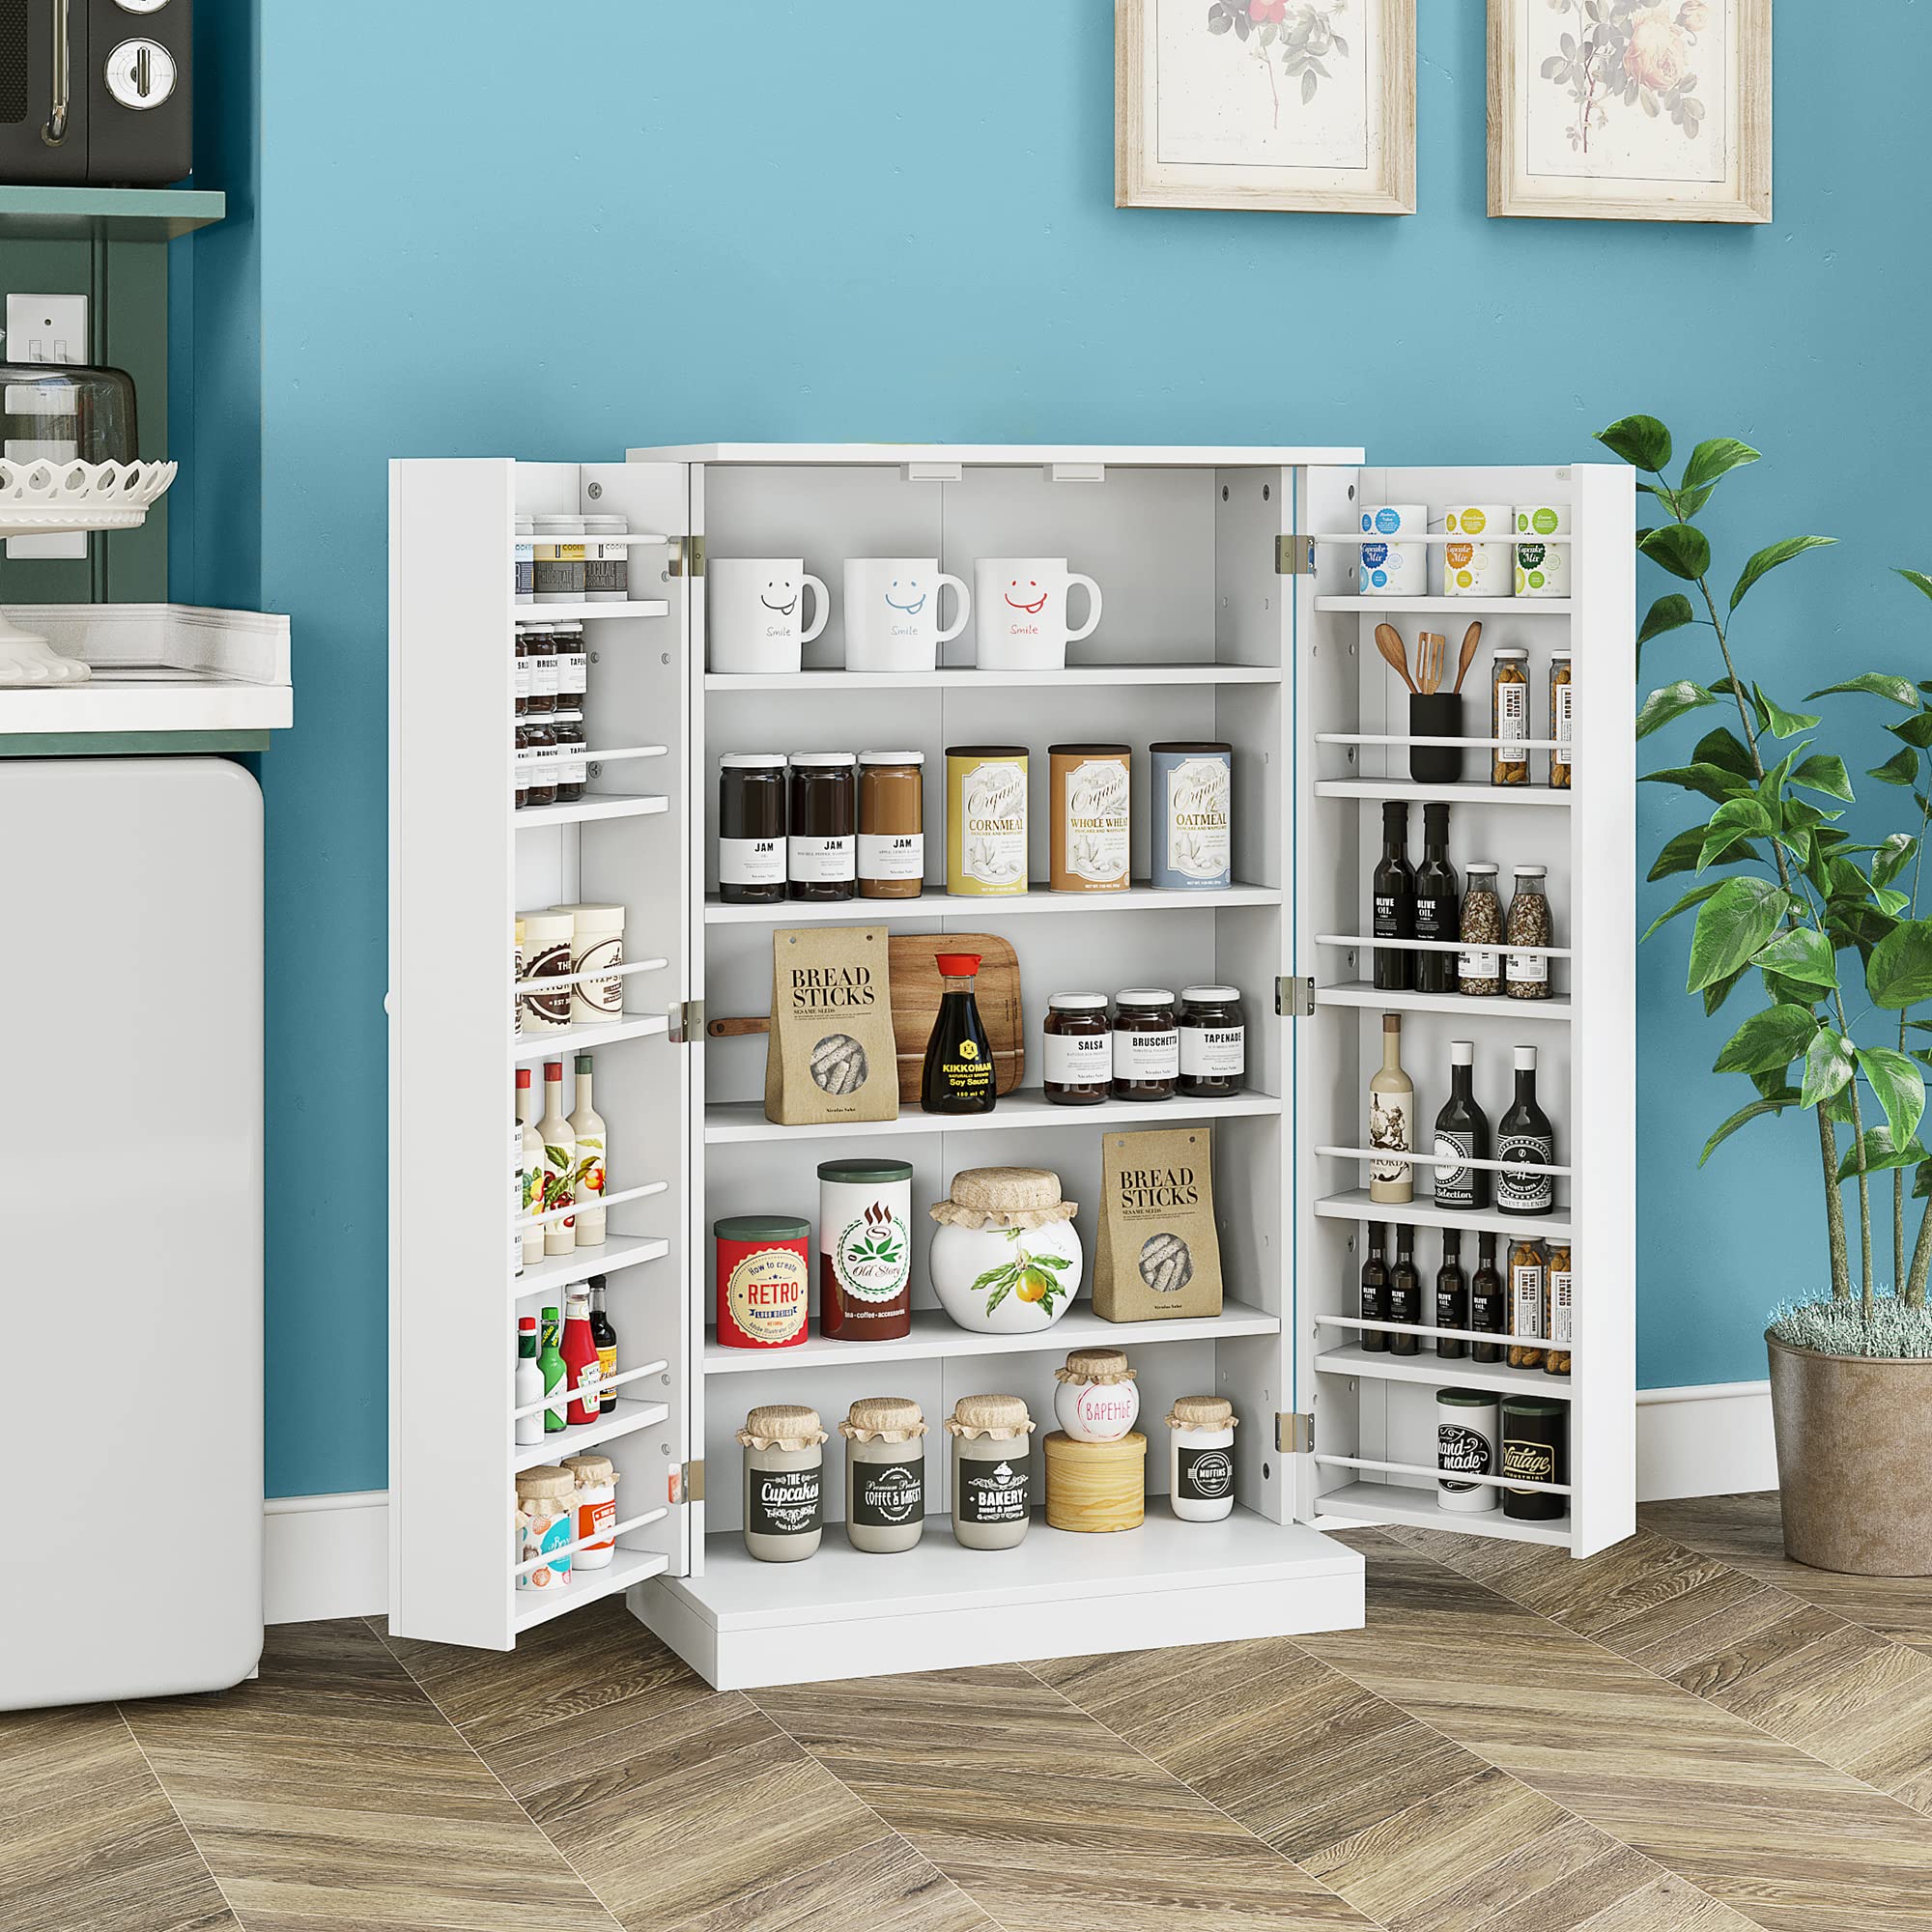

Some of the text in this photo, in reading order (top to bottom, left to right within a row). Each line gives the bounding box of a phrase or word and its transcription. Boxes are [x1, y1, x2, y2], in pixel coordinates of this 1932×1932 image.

[766, 626, 791, 638] Smile
[890, 625, 919, 637] Smile
[1009, 624, 1039, 636] Smile
[969, 819, 1024, 831] CORNMEAL
[1070, 818, 1104, 828] WHOLE
[1176, 812, 1227, 826] OATMEAL
[754, 842, 774, 852] JAM
[824, 840, 843, 850] JAM
[893, 838, 912, 848] JAM
[1376, 897, 1395, 907] OLIVE
[1417, 899, 1436, 909] OLIVE
[790, 966, 871, 988] BREAD
[792, 985, 875, 1009] STICKS
[1204, 1032, 1241, 1043] TAPENADE
[1078, 1040, 1104, 1051] SALSA
[942, 1063, 992, 1072] KIKKOMAN
[950, 1078, 965, 1087] Soy
[1120, 1167, 1194, 1190] BREAD
[1122, 1186, 1198, 1208] STICKS
[1436, 1187, 1472, 1199] Selection
[748, 1261, 798, 1275] How to create
[852, 1264, 900, 1278] Old Story
[748, 1281, 799, 1305] RETRO
[1086, 1401, 1131, 1421] ВАРЕНЬЕ
[1443, 1452, 1481, 1469] made
[1504, 1445, 1551, 1472] Vintage
[1199, 1467, 1226, 1478] MUFFINS
[786, 1473, 801, 1486] THE
[761, 1482, 819, 1507] Cupcakes
[865, 1491, 892, 1506] COFFEE
[893, 1492, 899, 1506] &
[978, 1488, 1024, 1506] BAKERY
